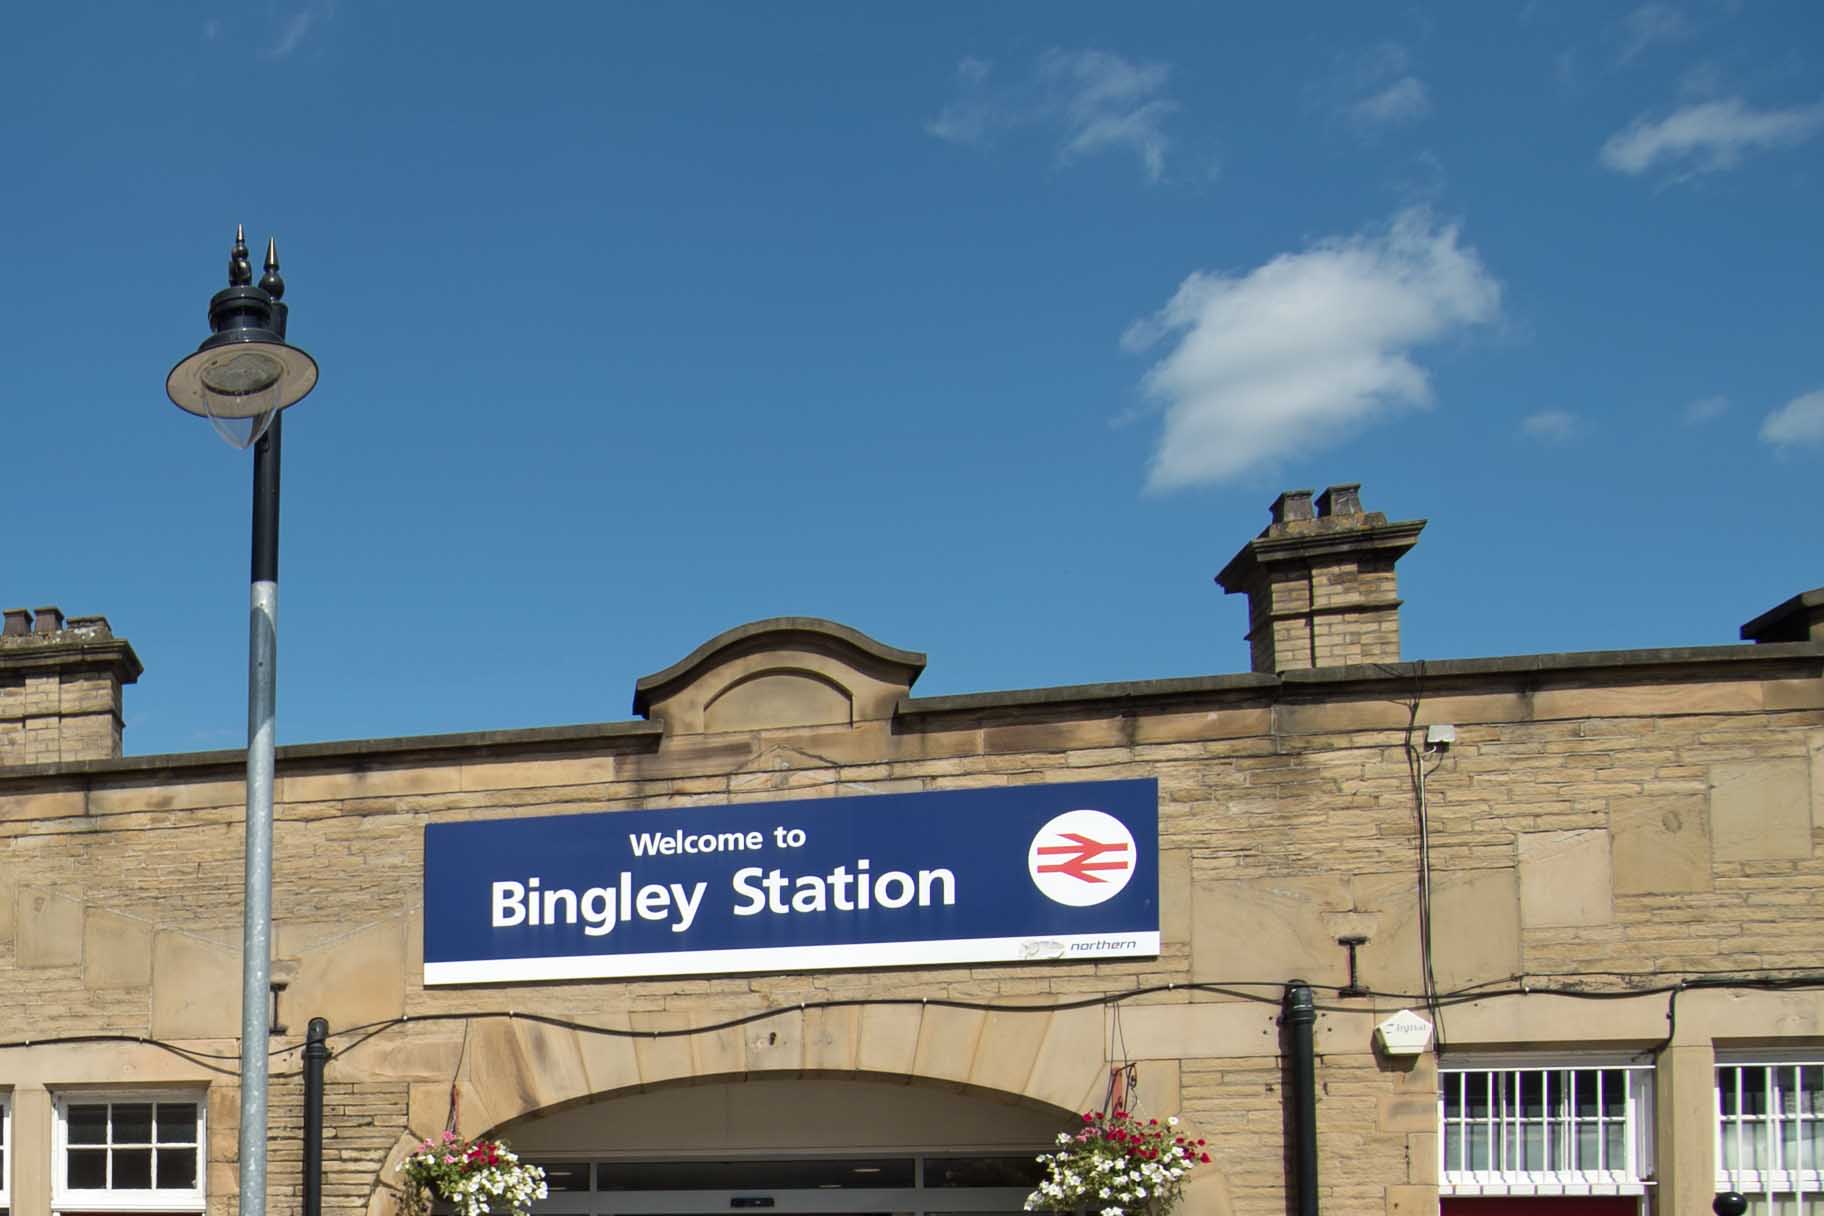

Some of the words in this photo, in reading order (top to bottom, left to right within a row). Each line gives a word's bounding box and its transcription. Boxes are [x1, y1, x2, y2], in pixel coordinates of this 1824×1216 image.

[630, 829, 764, 857] Welcome
[774, 826, 807, 849] to
[492, 871, 708, 937] Bingley
[732, 858, 956, 916] Station
[1070, 940, 1137, 951] northern
